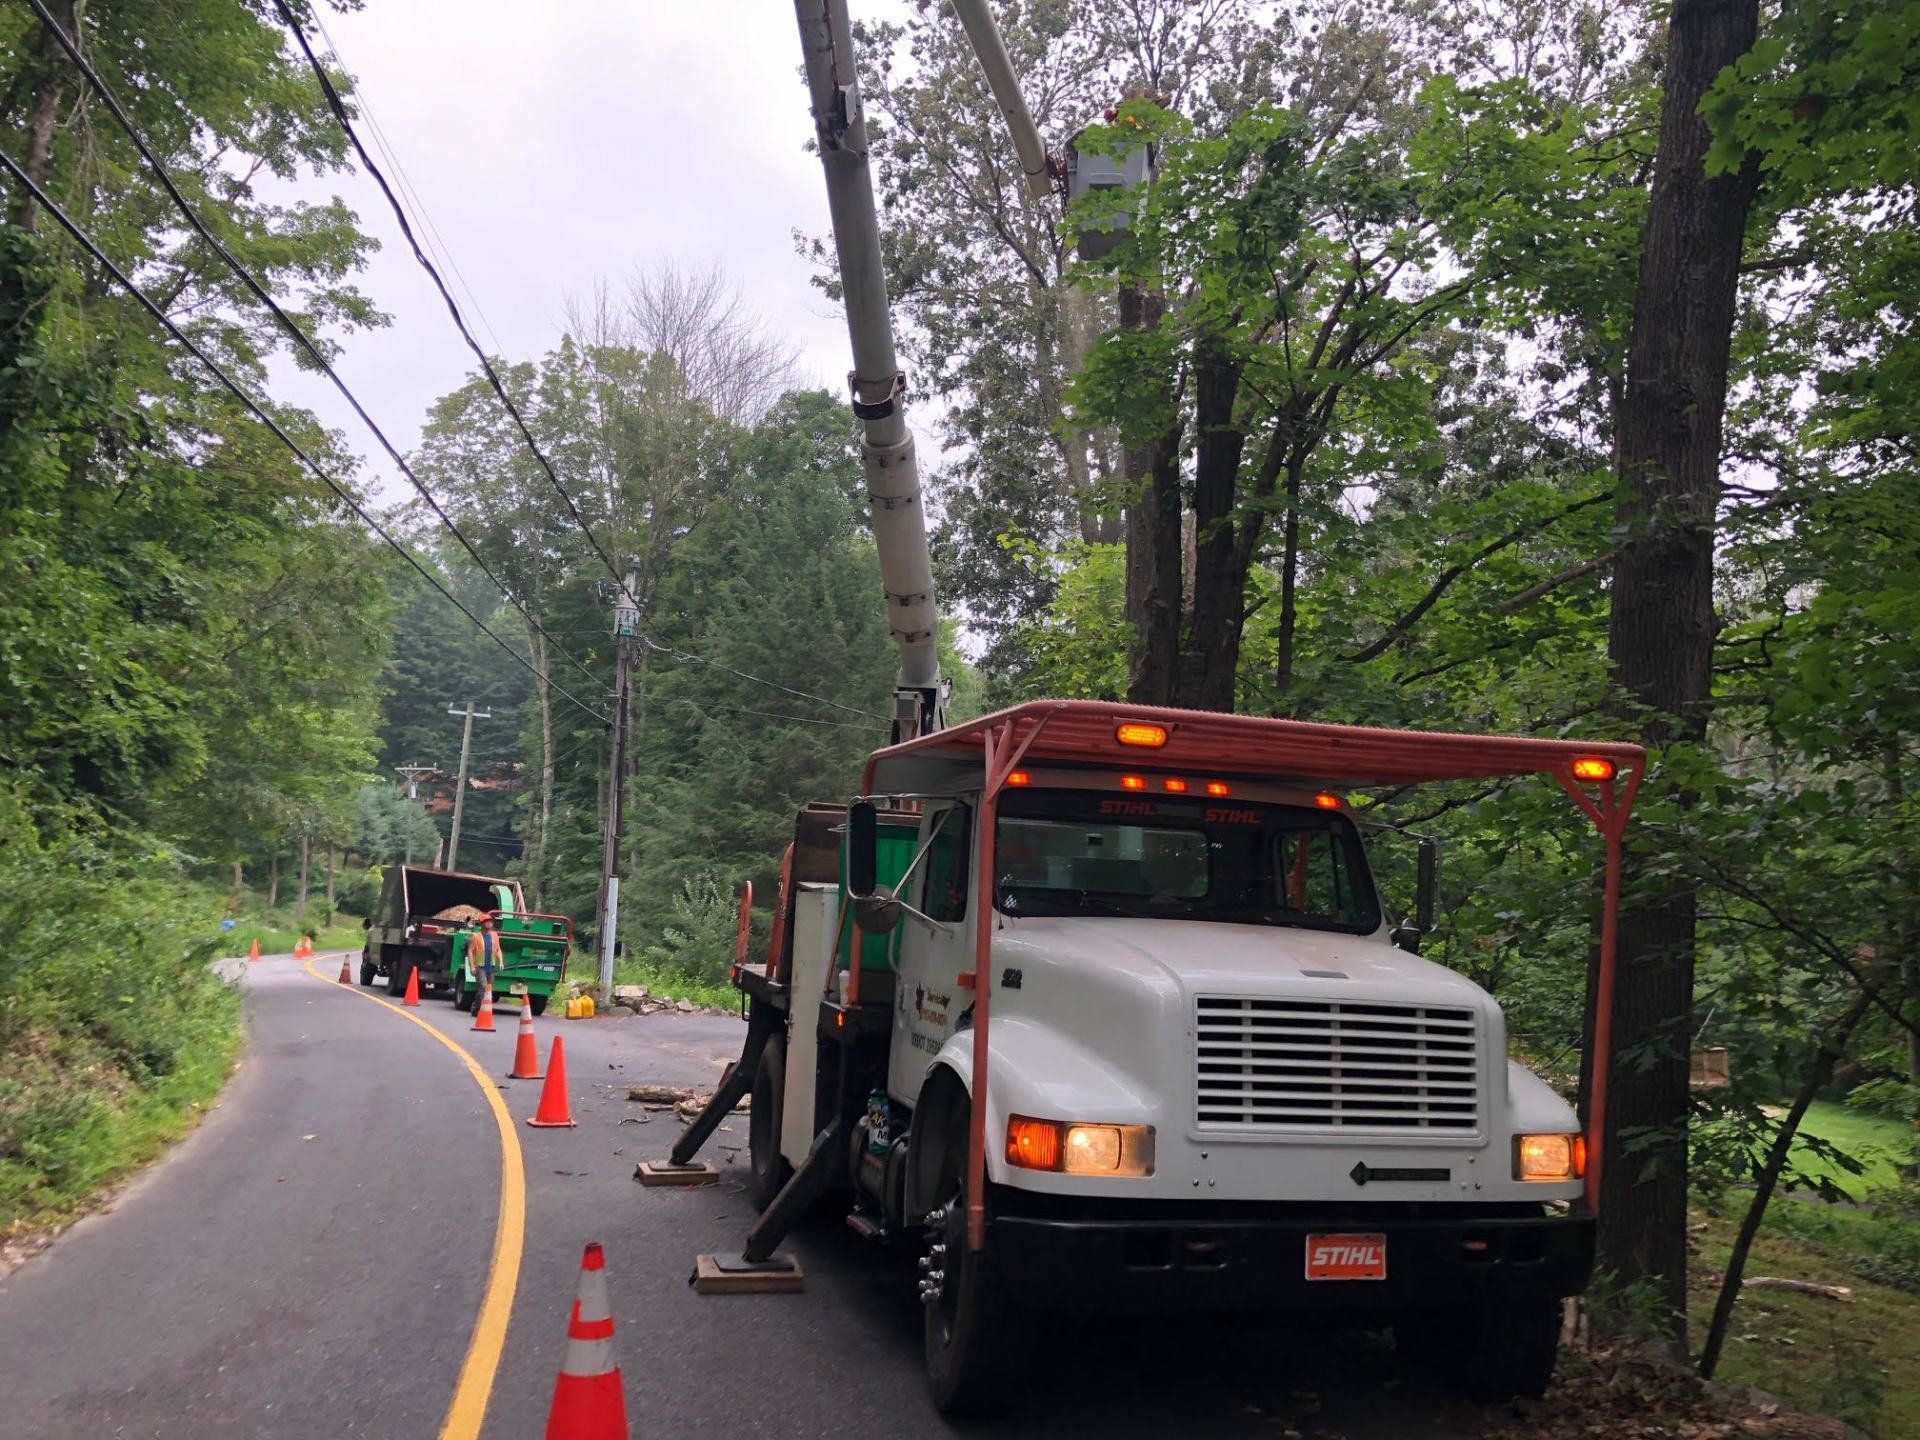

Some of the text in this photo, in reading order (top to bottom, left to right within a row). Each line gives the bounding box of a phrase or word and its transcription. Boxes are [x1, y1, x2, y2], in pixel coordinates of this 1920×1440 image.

[1100, 801, 1157, 816] STIHL
[1204, 808, 1262, 824] STIHL
[1311, 1246, 1380, 1266] STIHL
